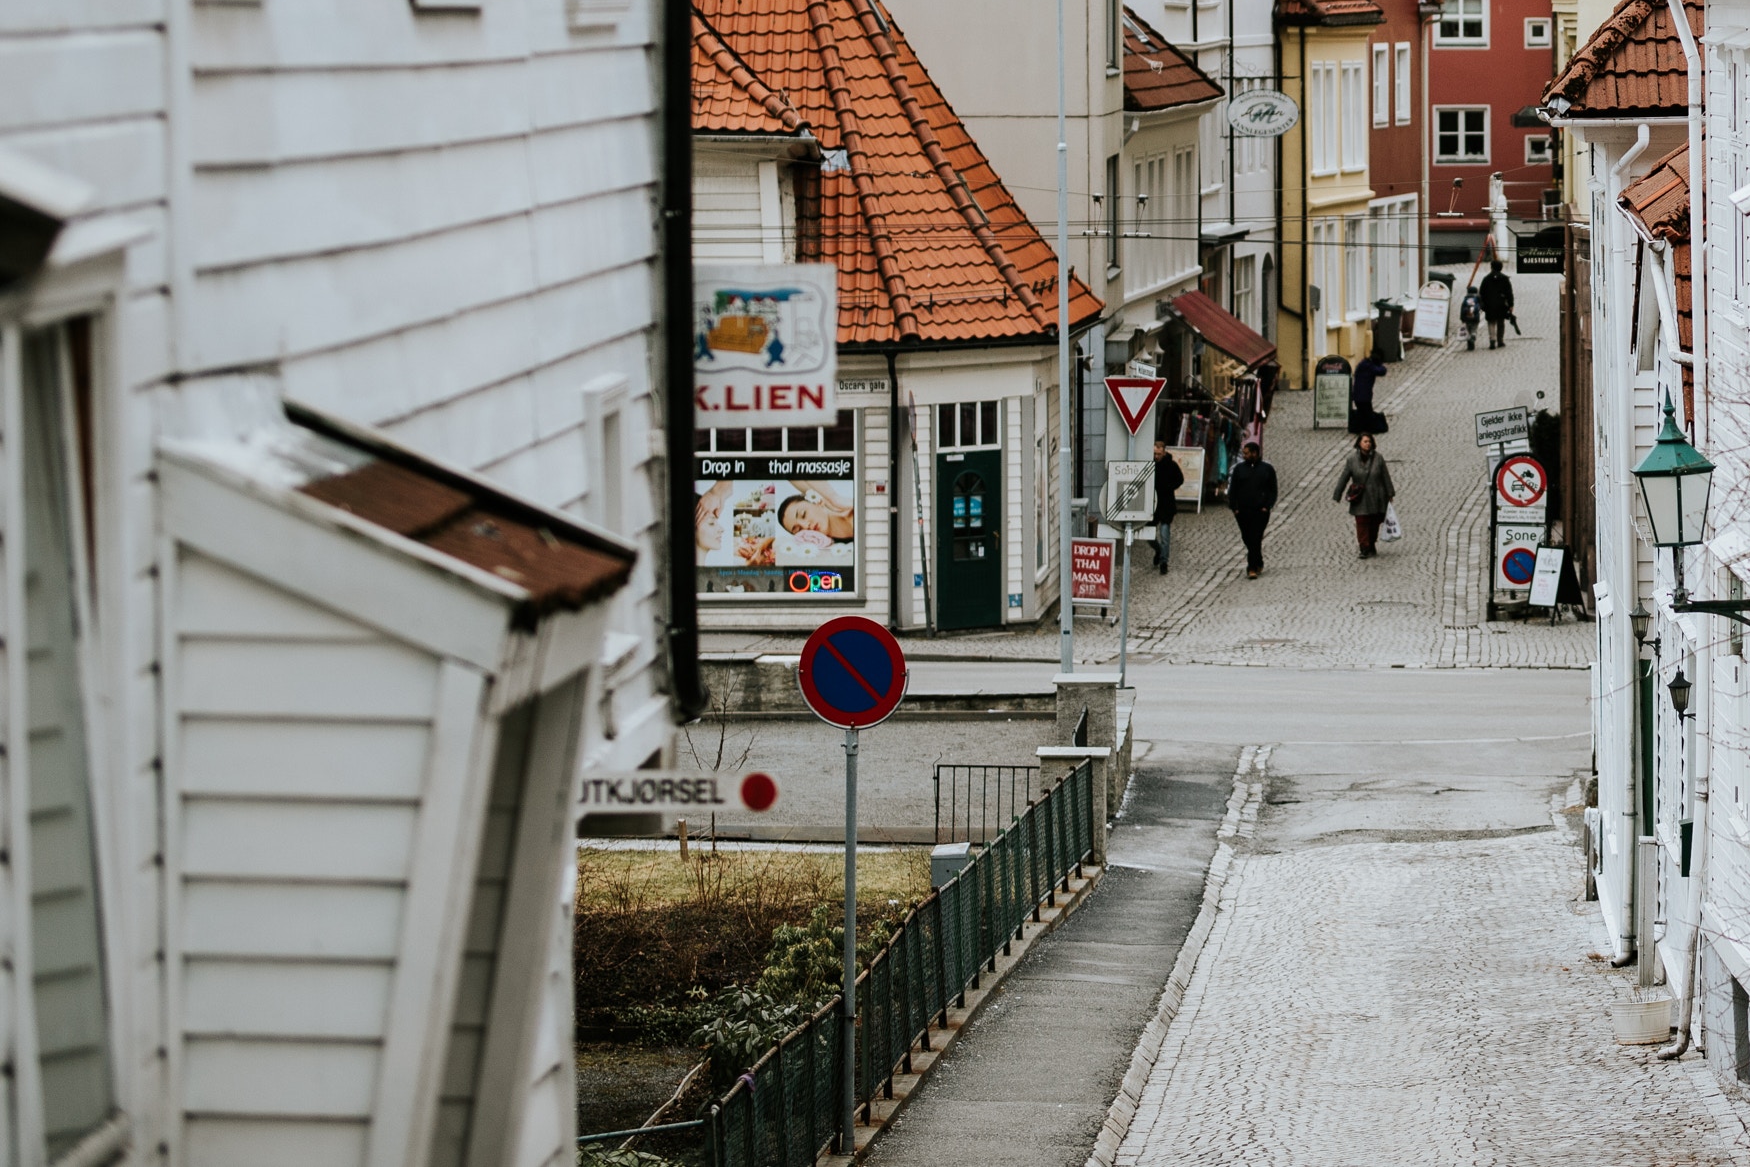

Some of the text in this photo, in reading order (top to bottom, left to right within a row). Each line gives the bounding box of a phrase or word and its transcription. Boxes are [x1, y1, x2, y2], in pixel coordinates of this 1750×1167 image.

[839, 380, 886, 393] Oscars gate
[1481, 412, 1523, 428] Gjelder ikke
[1478, 424, 1527, 440] anleggstrafikk
[702, 459, 731, 477] Drop
[768, 459, 793, 474] thai
[795, 459, 851, 477] massasje
[1505, 528, 1538, 541] Sone
[1073, 545, 1110, 557] DROP IN
[1074, 558, 1100, 570] THAI
[789, 571, 842, 593] Open
[1072, 571, 1106, 584] MASSA
